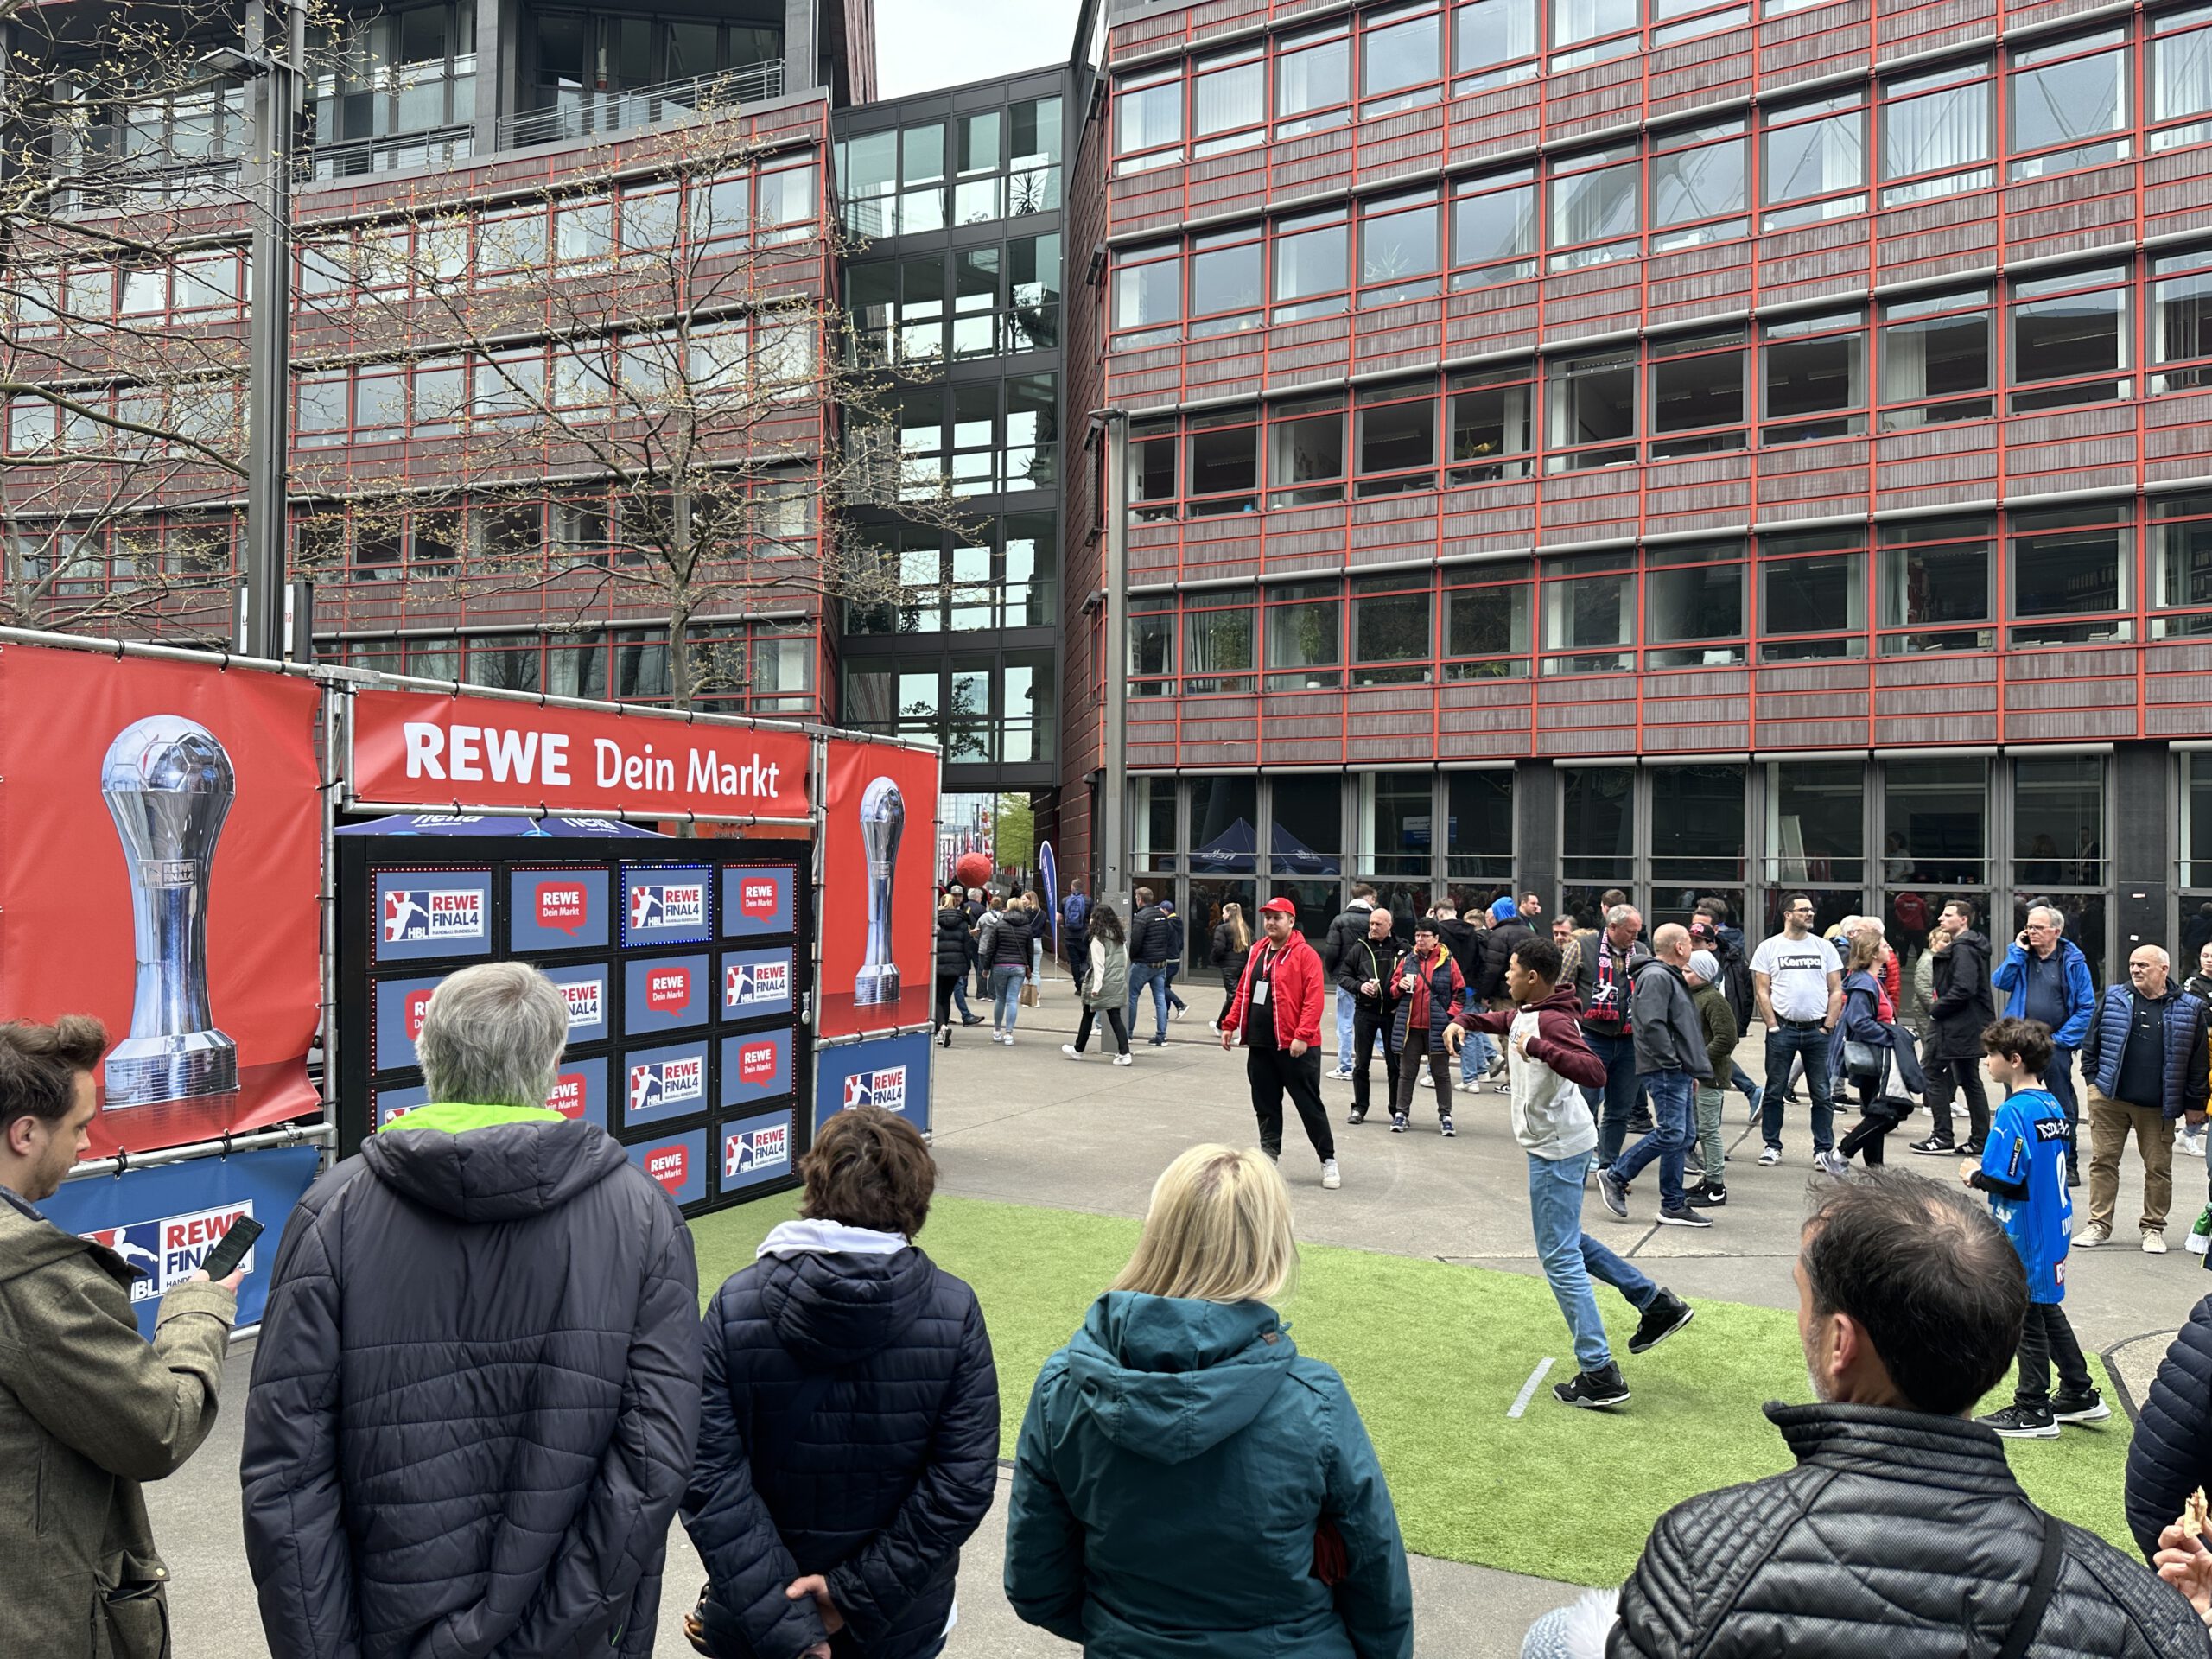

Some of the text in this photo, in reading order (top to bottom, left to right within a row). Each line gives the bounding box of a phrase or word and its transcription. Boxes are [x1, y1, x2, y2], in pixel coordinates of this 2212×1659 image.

[403, 722, 779, 798] REWE Dein Markt
[665, 890, 699, 903] REWE
[746, 885, 772, 897] REWE
[433, 895, 479, 911] REWE
[543, 892, 579, 906] REWE
[543, 907, 579, 917] Dein Markt
[666, 904, 699, 916] FINAL4
[433, 912, 479, 926] FINAL4
[1779, 957, 1821, 968] Kempa
[756, 966, 785, 980] REWE
[652, 976, 683, 990] REWE
[756, 979, 785, 992] FINAL4
[652, 989, 683, 1001] Dein Markt
[568, 1001, 597, 1015] NAL4
[745, 1049, 771, 1064] REWE
[665, 1062, 698, 1079] REWE
[744, 1062, 771, 1074] Dein Markt
[665, 1076, 698, 1093] FINAL4
[874, 1071, 902, 1090] REWE
[547, 1082, 578, 1101] EWE
[874, 1087, 902, 1105] FINAL4
[558, 1098, 578, 1109] Markt
[756, 1128, 785, 1147] REWE
[755, 1142, 785, 1160] FINAL4
[651, 1153, 682, 1172] REWE
[664, 1168, 682, 1179] Markt
[167, 1243, 215, 1274] FIN
